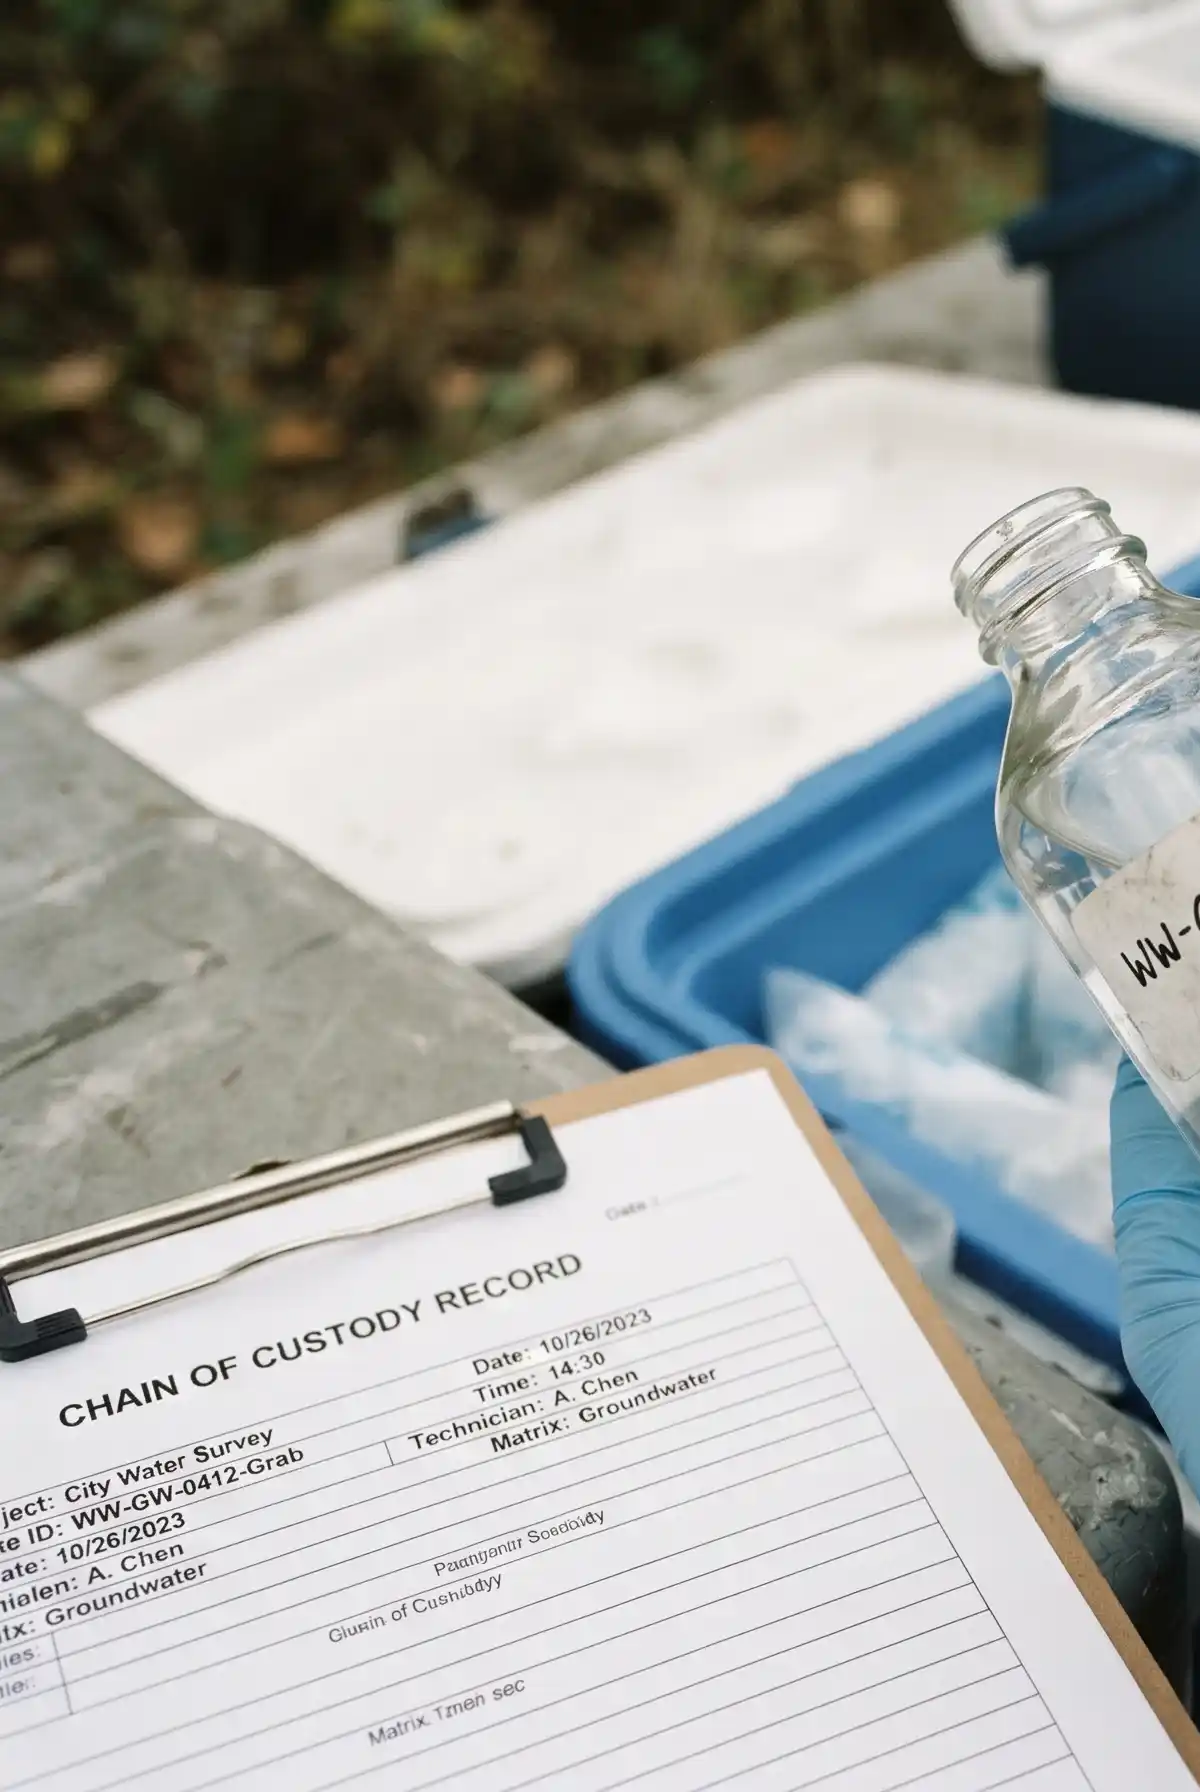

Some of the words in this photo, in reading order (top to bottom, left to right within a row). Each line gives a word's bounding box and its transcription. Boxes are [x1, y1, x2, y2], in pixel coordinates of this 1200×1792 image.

[58, 1375, 179, 1429] CHAIN
[189, 1355, 241, 1390] OF
[251, 1299, 423, 1369] CUSTODY
[433, 1252, 583, 1314] RECORD
[471, 1346, 532, 1376] Date:
[539, 1307, 653, 1355] 10/26/2023
[407, 1398, 546, 1451] Technician:
[553, 1389, 577, 1407] A.
[580, 1368, 640, 1397] Chen
[472, 1373, 539, 1404] Time:
[548, 1350, 607, 1381] 14:30
[489, 1415, 571, 1453] Matrix:
[577, 1366, 718, 1425] Groundwater
[1, 1496, 55, 1530] ject:
[64, 1479, 111, 1504] City
[117, 1455, 186, 1486] Water
[193, 1428, 274, 1463] Survey
[27, 1523, 63, 1545] ID:
[71, 1446, 304, 1530] WW-GW-0412-Grab
[56, 1511, 186, 1565] 10/26/2023
[87, 1565, 114, 1585] A.
[120, 1543, 185, 1573] Chen
[45, 1560, 207, 1627] Groundwater
[391, 1603, 408, 1623] of
[492, 1679, 526, 1702] sec
